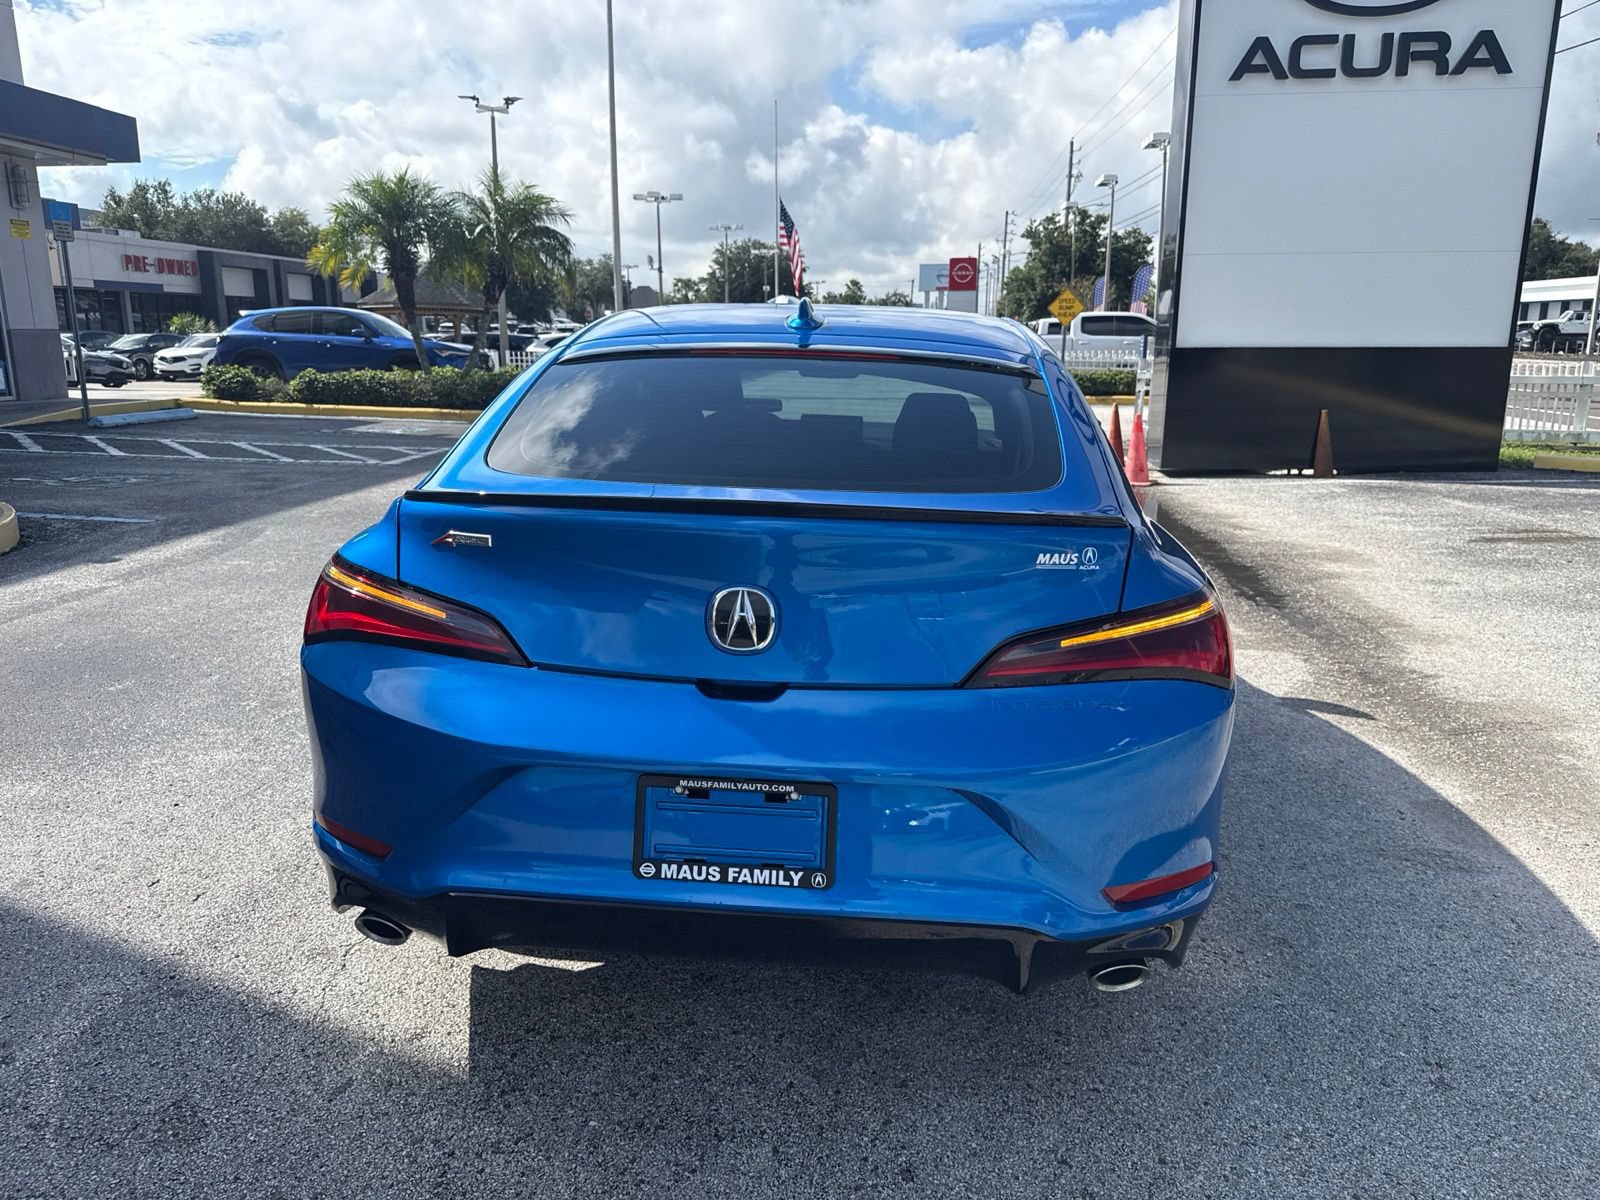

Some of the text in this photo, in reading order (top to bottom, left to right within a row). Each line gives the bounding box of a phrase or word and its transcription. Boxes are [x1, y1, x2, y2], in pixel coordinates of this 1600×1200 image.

[1228, 29, 1513, 82] ACURA
[122, 254, 198, 276] PRE-OWNED
[1036, 553, 1079, 565] MAUS
[679, 779, 795, 792] MAUSFAMILYAUTO.COM
[661, 863, 804, 886] MAUS FAMILY
